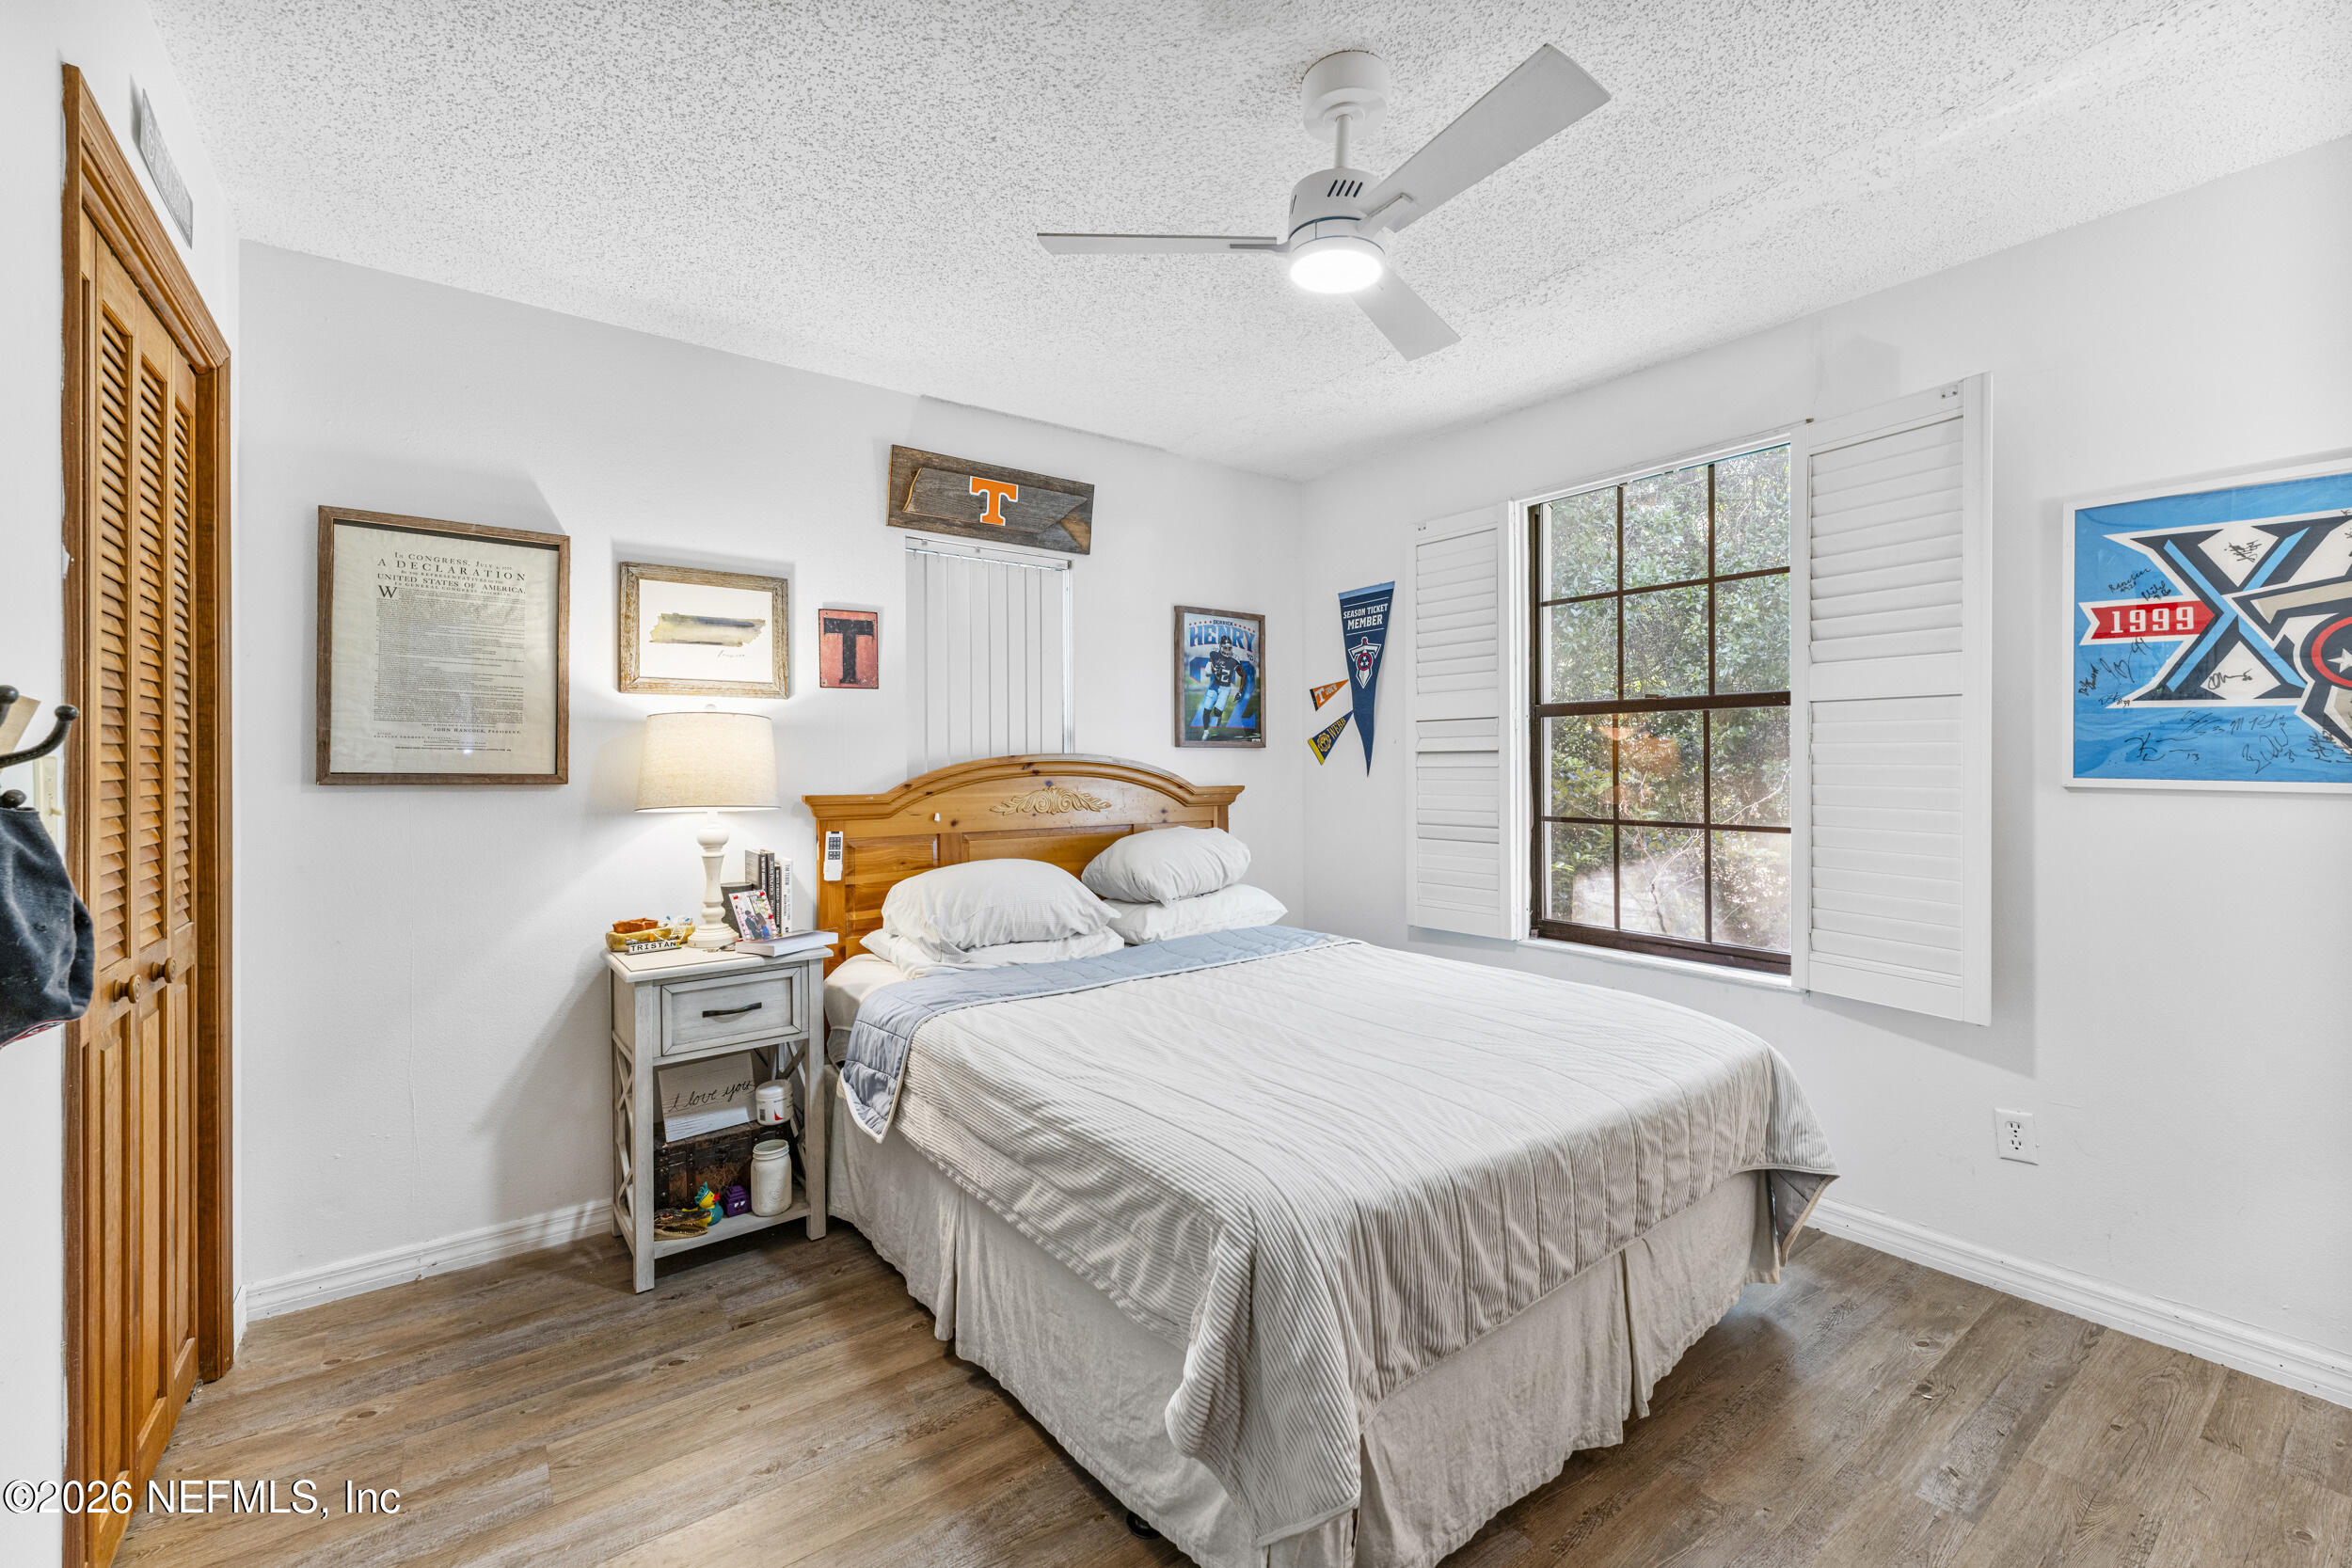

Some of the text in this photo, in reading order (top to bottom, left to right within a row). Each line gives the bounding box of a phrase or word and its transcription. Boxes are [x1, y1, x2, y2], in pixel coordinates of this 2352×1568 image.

[969, 476, 1019, 527] T
[377, 558, 525, 581] A DECLARATION
[408, 553, 470, 566] CONGRESS,
[377, 573, 418, 583] UNITED
[422, 577, 459, 587] STATES
[1343, 603, 1389, 620] SEASON TICKET
[1347, 614, 1383, 630] MEMBER
[2110, 606, 2195, 634] 1999
[1189, 625, 1256, 653] HENRY
[824, 617, 874, 686] T
[1315, 688, 1326, 704] T
[1327, 717, 1346, 740] WEBB
[630, 942, 676, 952] TRISTAN
[684, 1089, 718, 1108] love
[721, 1080, 755, 1103] you
